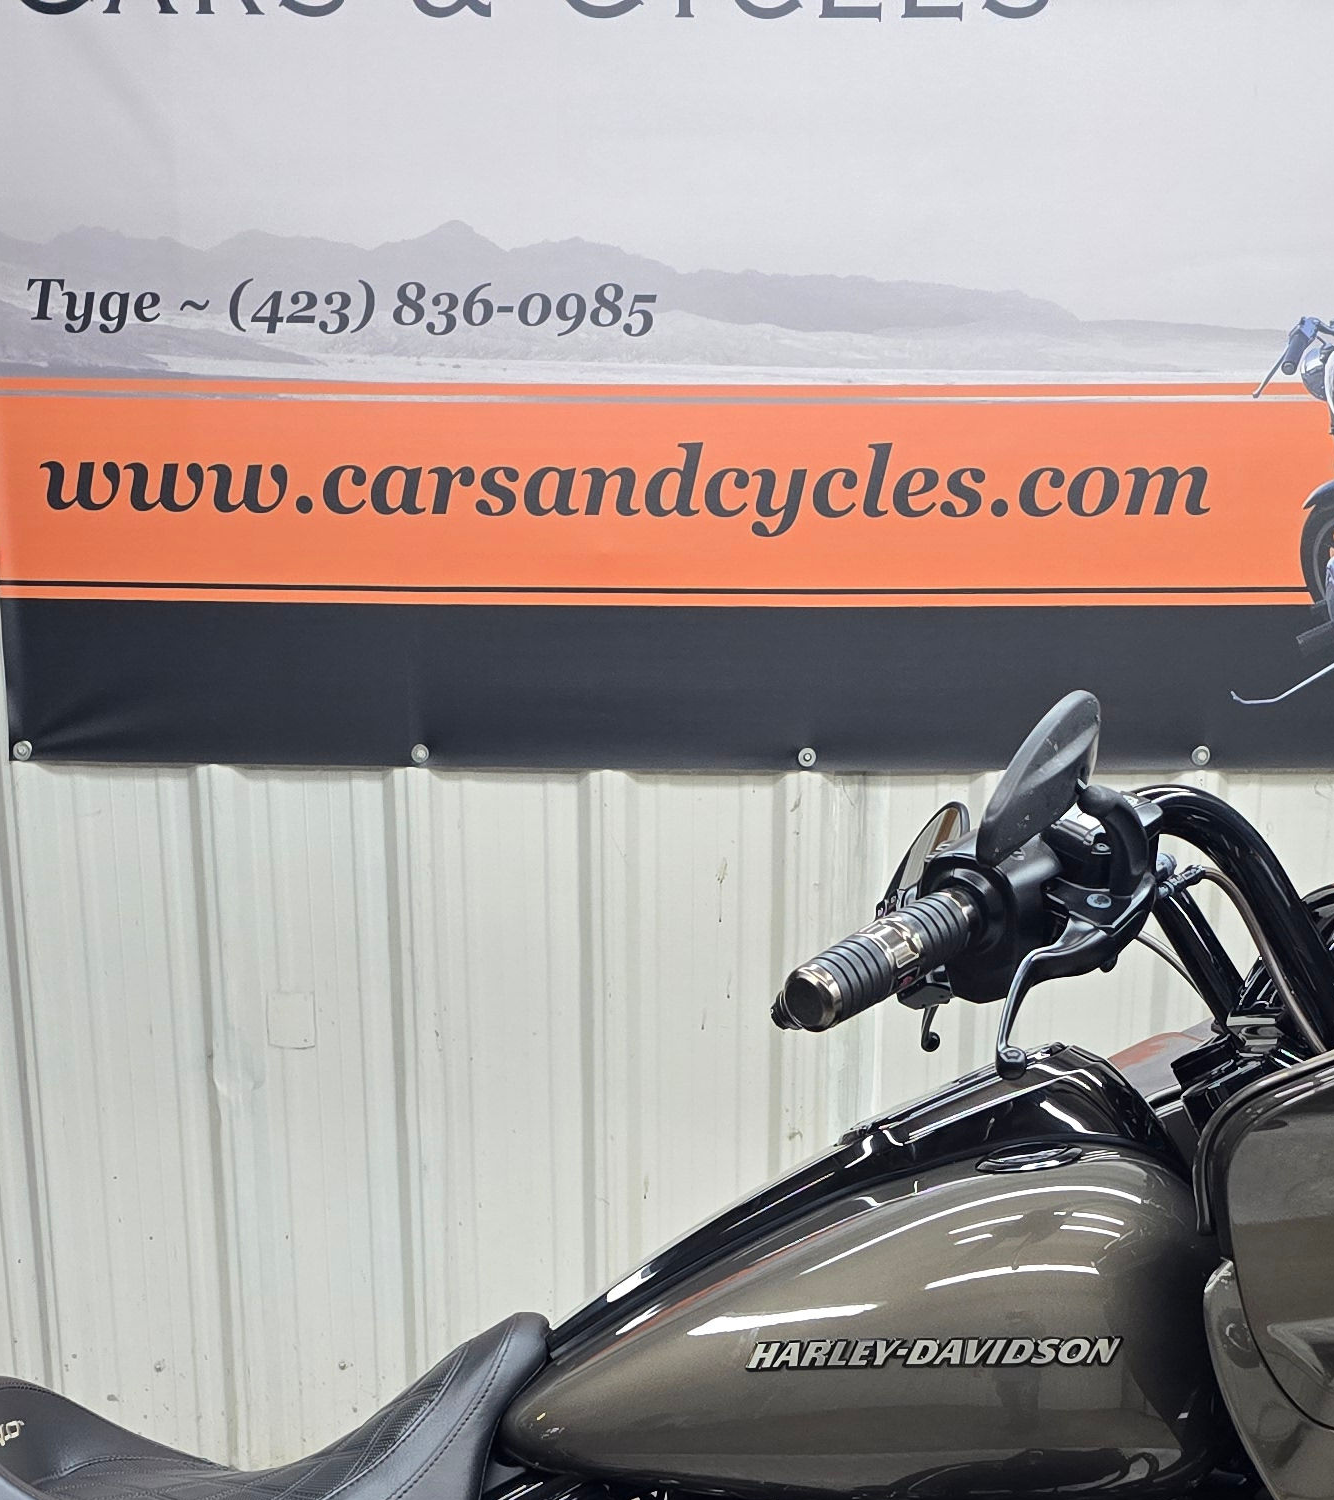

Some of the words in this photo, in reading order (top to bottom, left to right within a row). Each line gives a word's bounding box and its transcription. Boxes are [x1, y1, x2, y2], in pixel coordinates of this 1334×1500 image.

[26, 278, 161, 333] Tyge
[229, 278, 376, 335] (423)
[392, 281, 657, 337] 836-0985
[40, 441, 1212, 538] www.carsandcycles.com
[745, 1335, 1123, 1372] HARLEY-DAVIDSON
